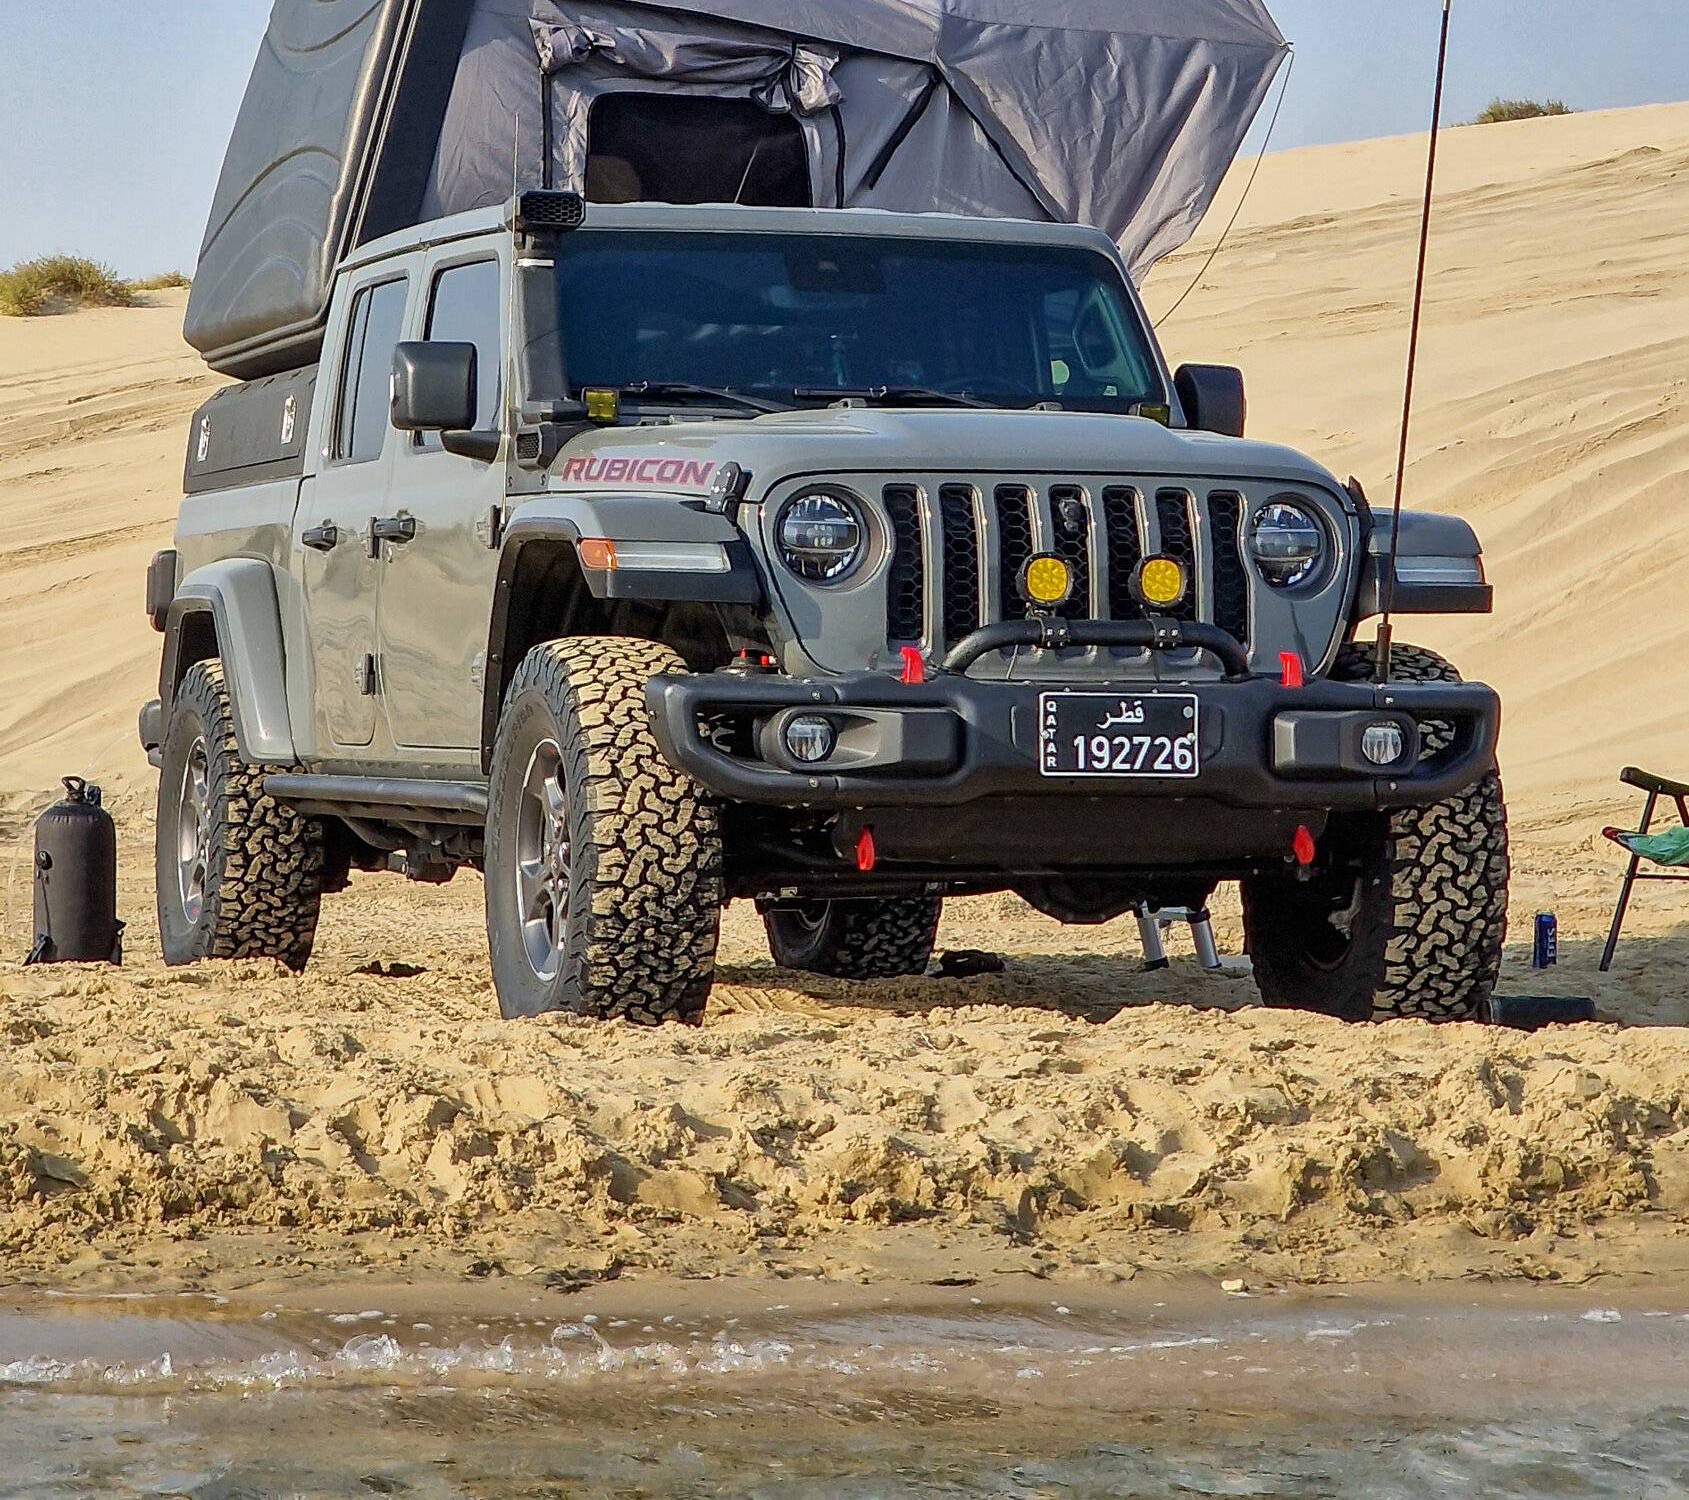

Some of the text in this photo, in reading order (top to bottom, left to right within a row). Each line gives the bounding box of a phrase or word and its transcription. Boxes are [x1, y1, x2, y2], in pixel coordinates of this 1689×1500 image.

[561, 457, 715, 486] RUBICON
[1095, 700, 1145, 730] قطر
[1045, 700, 1058, 768] QATAR
[1073, 735, 1193, 770] 192726
